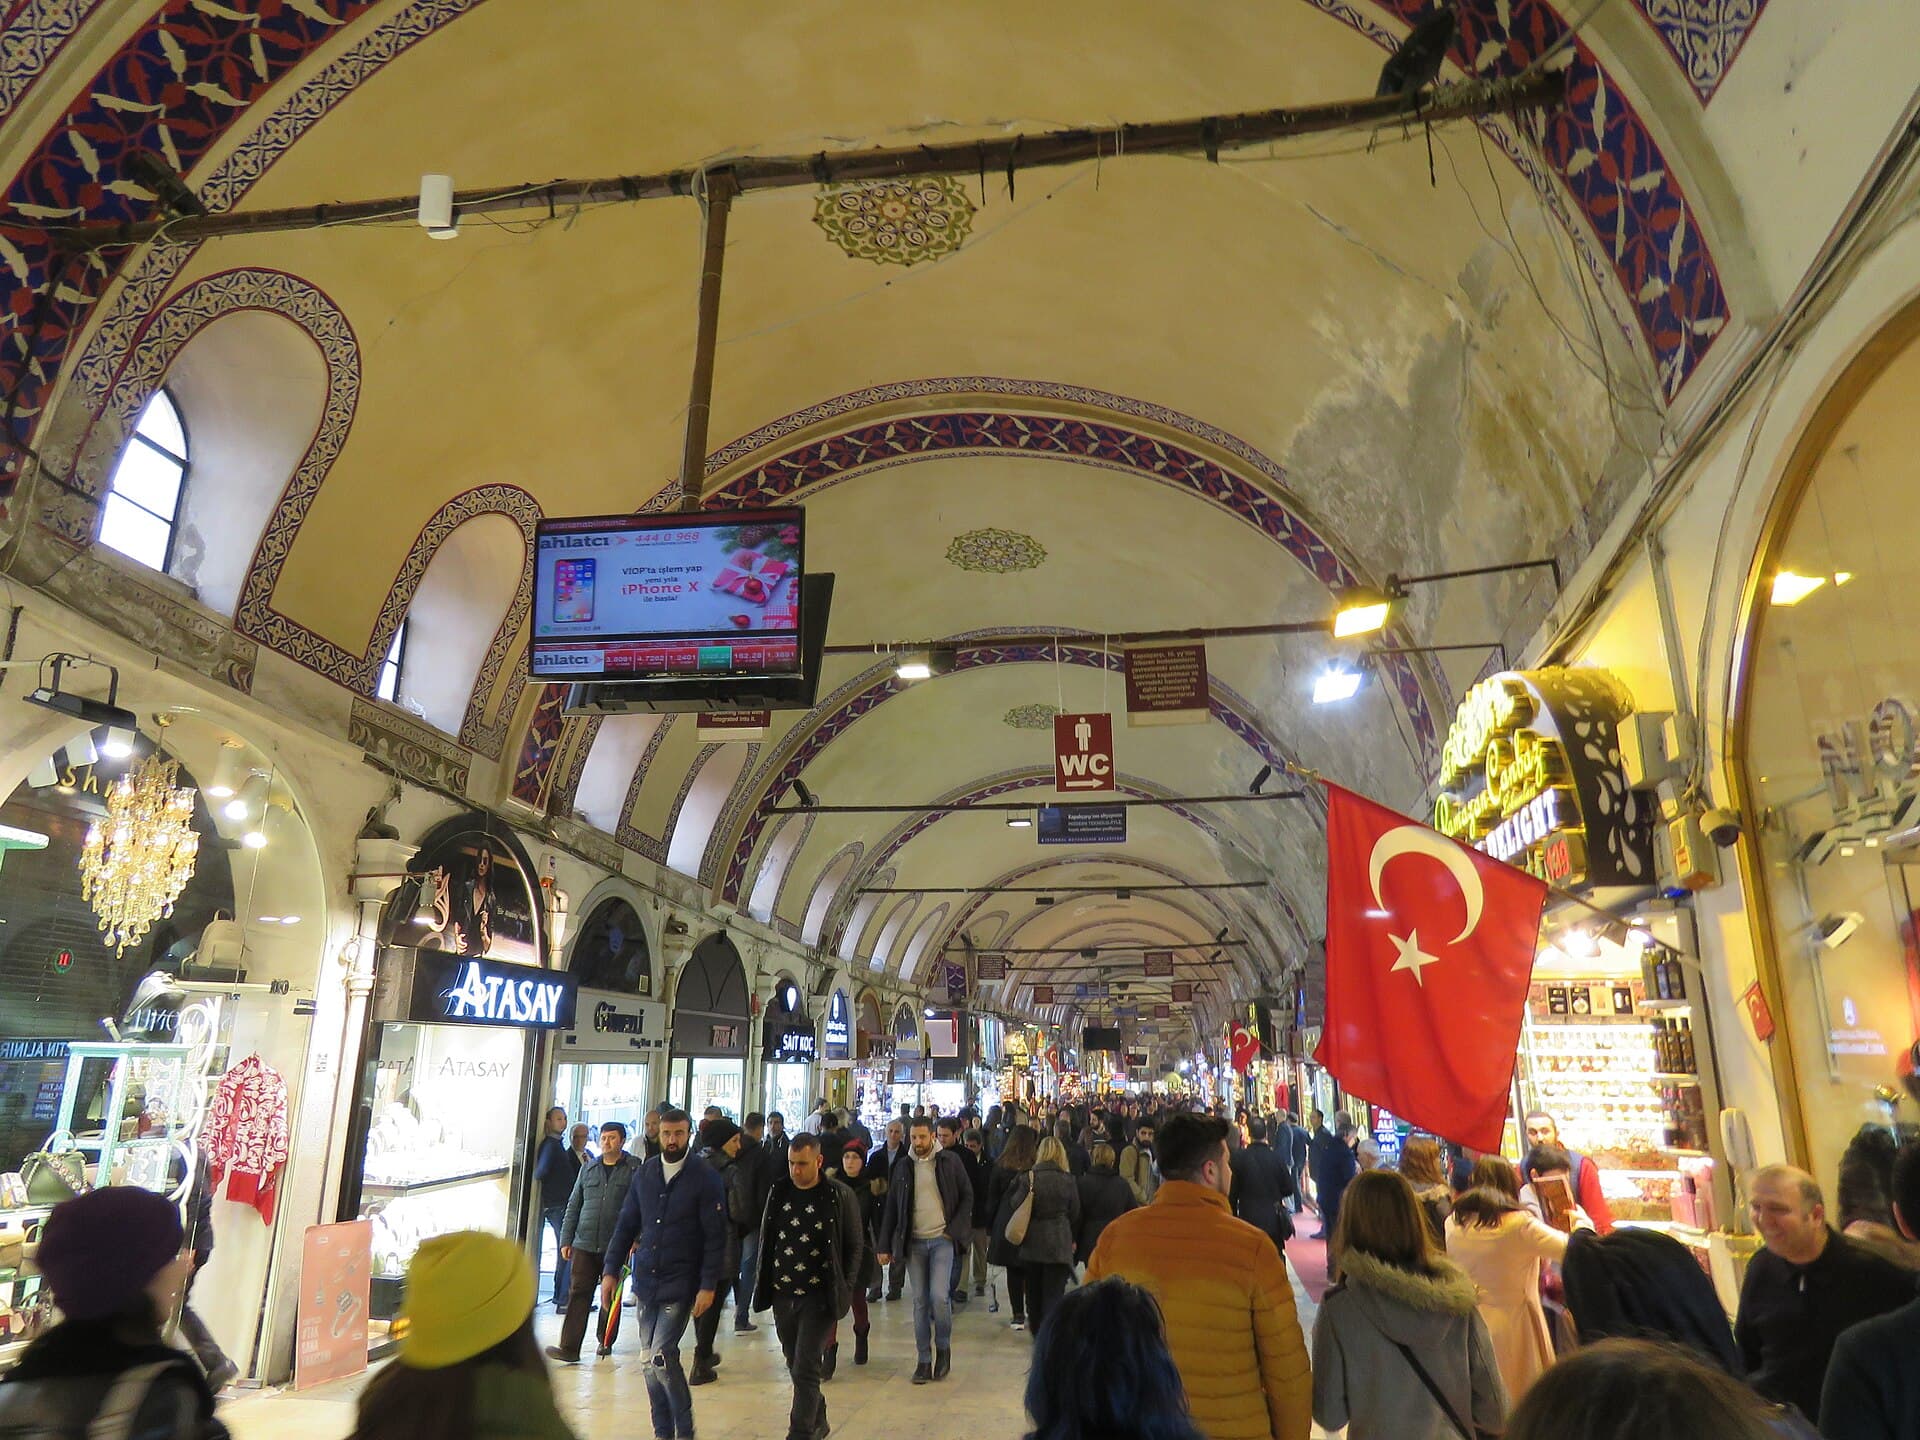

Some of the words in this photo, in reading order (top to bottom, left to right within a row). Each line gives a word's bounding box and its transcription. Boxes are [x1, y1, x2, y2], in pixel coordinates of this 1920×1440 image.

[635, 533, 659, 542] 444
[621, 583, 682, 595] iPhone
[688, 581, 699, 592] X
[1060, 753, 1109, 776] WC
[442, 962, 563, 1022] ATASAY
[782, 1031, 799, 1050] SAİT
[799, 1036, 814, 1056] KOÇ
[440, 1057, 510, 1077] ATASAY
